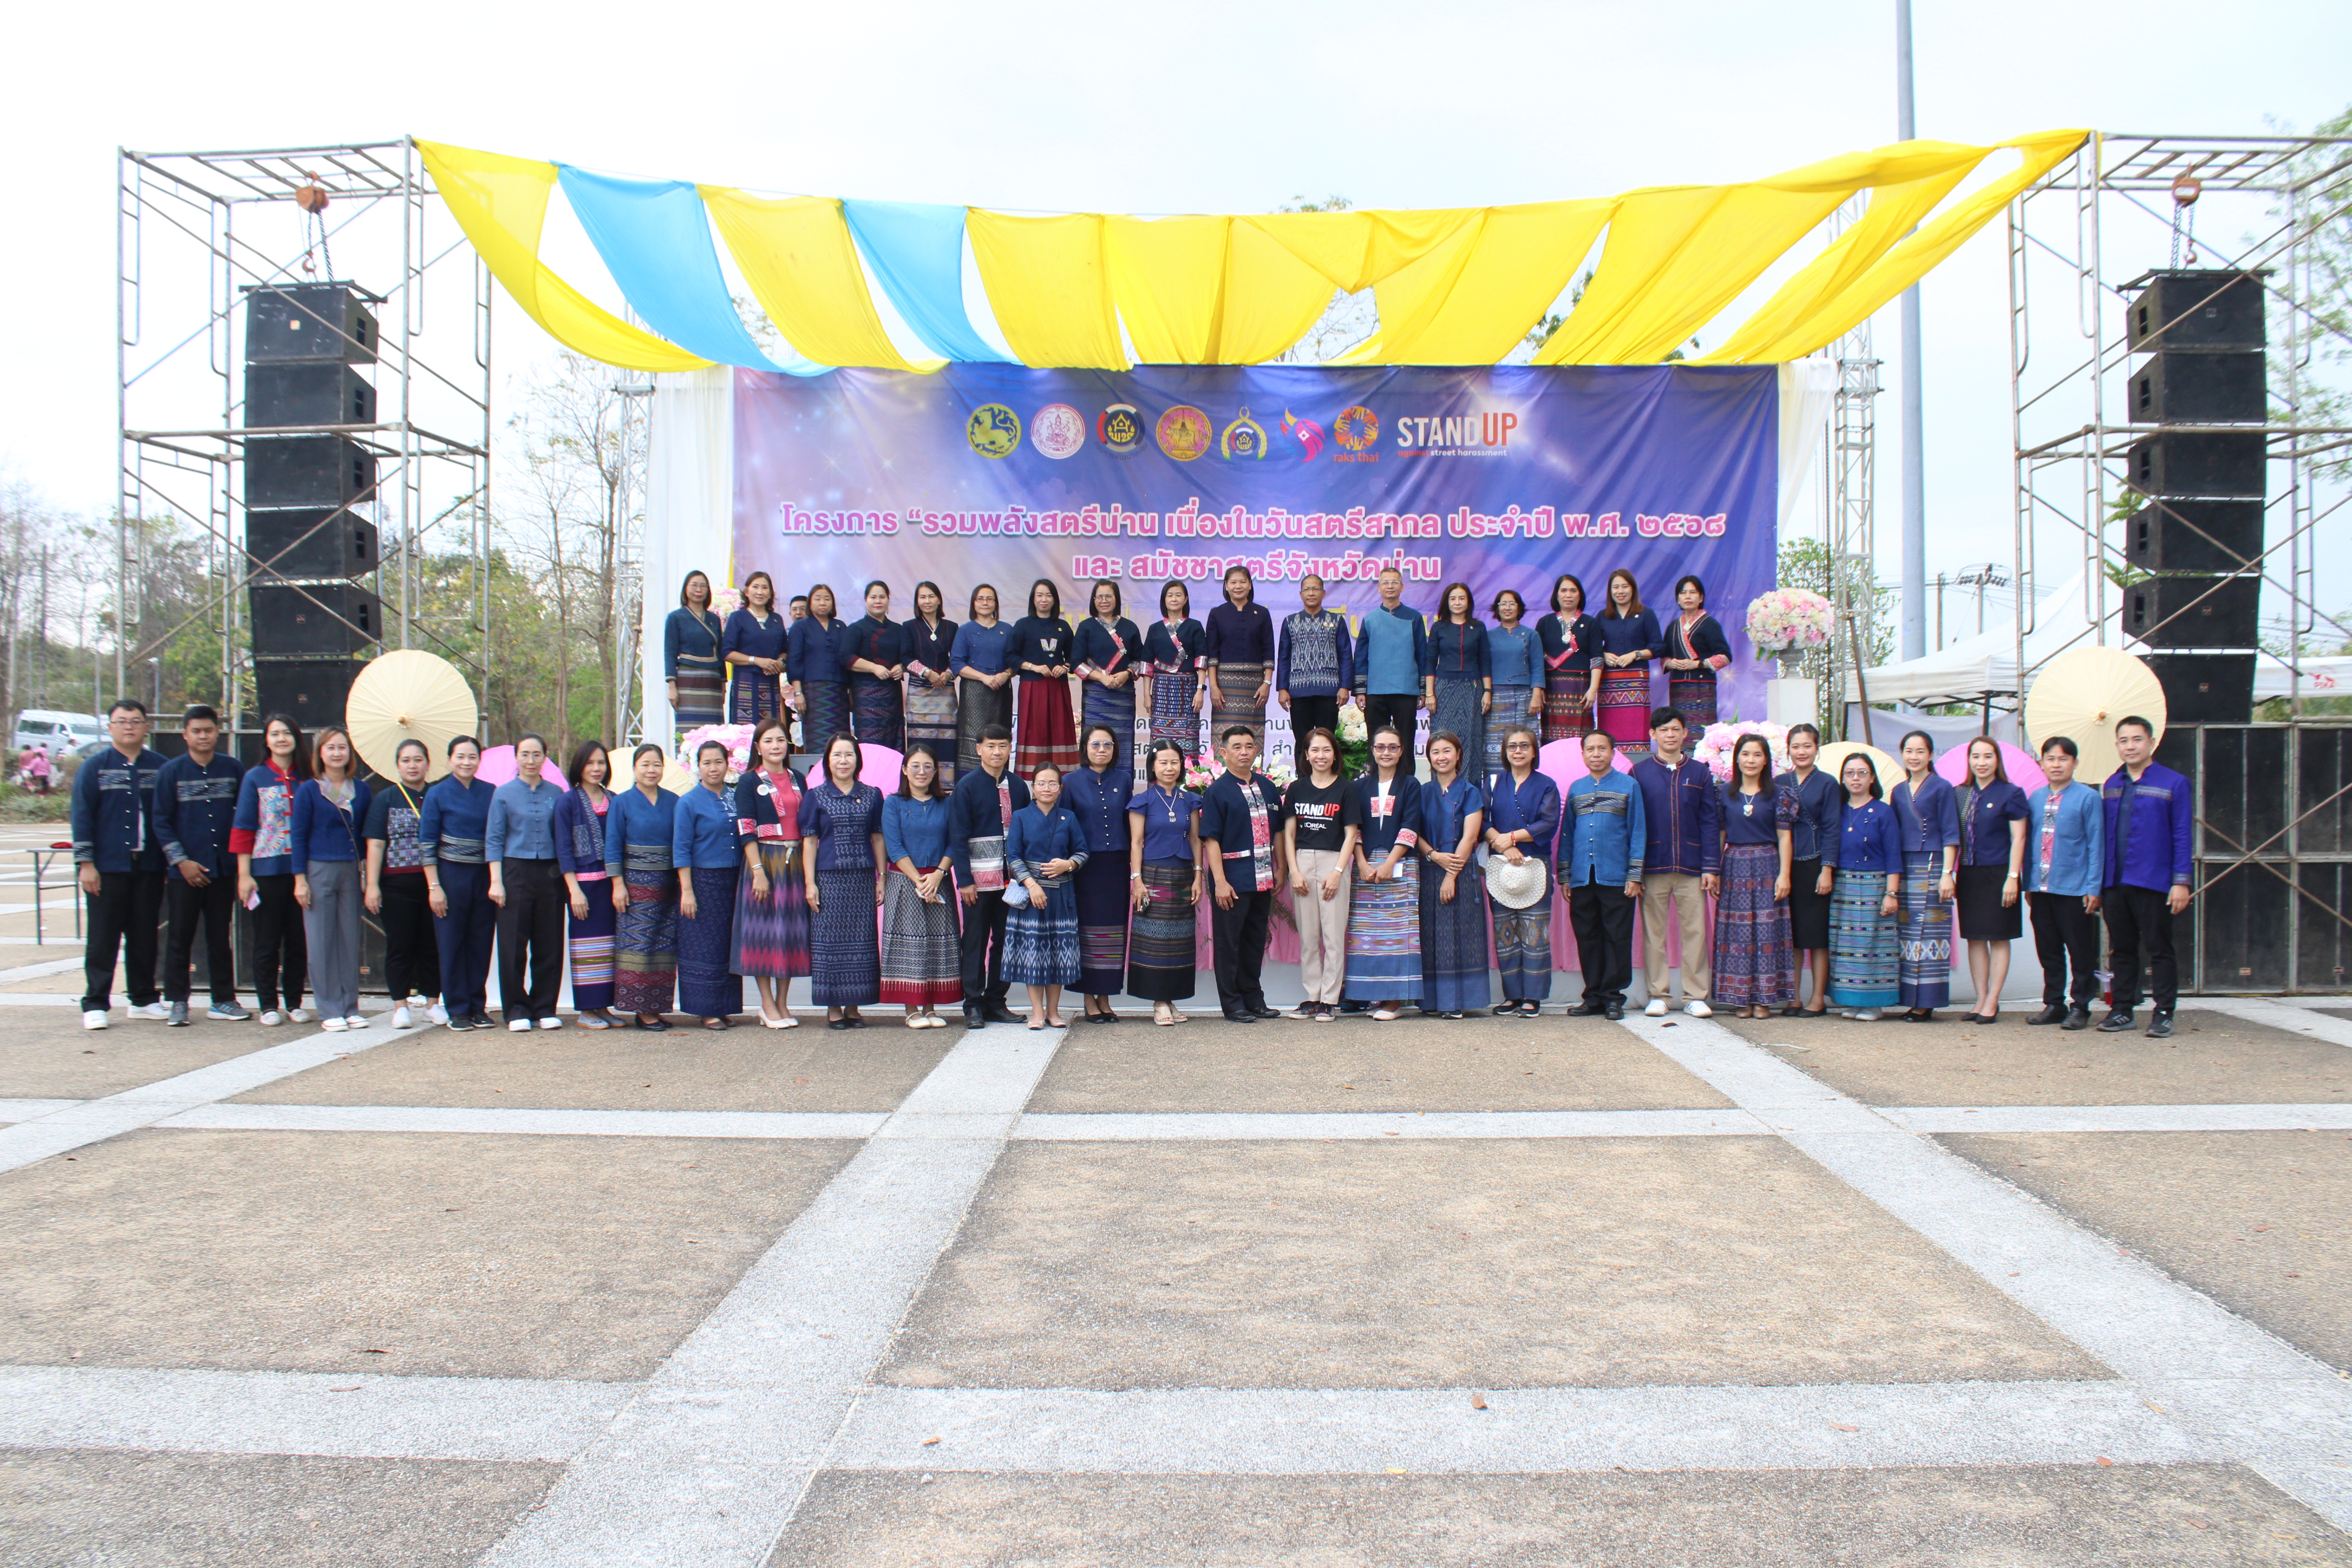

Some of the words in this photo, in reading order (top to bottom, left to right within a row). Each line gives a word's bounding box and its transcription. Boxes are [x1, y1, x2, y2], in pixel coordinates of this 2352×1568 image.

[1333, 452, 1355, 463] raks
[1357, 452, 1379, 463] thai
[1397, 449, 1429, 458] against
[780, 502, 899, 535] โครงการ
[907, 503, 1158, 536] “รวมพลังสตรีน่าน
[1165, 496, 1441, 539] เนื่องในวันสตรีสากล
[1448, 504, 1555, 538] ประจำปี
[1562, 511, 1629, 537] พ.ศ.
[1635, 512, 1727, 538] ๒๕๖๘
[1072, 554, 1122, 579] และ
